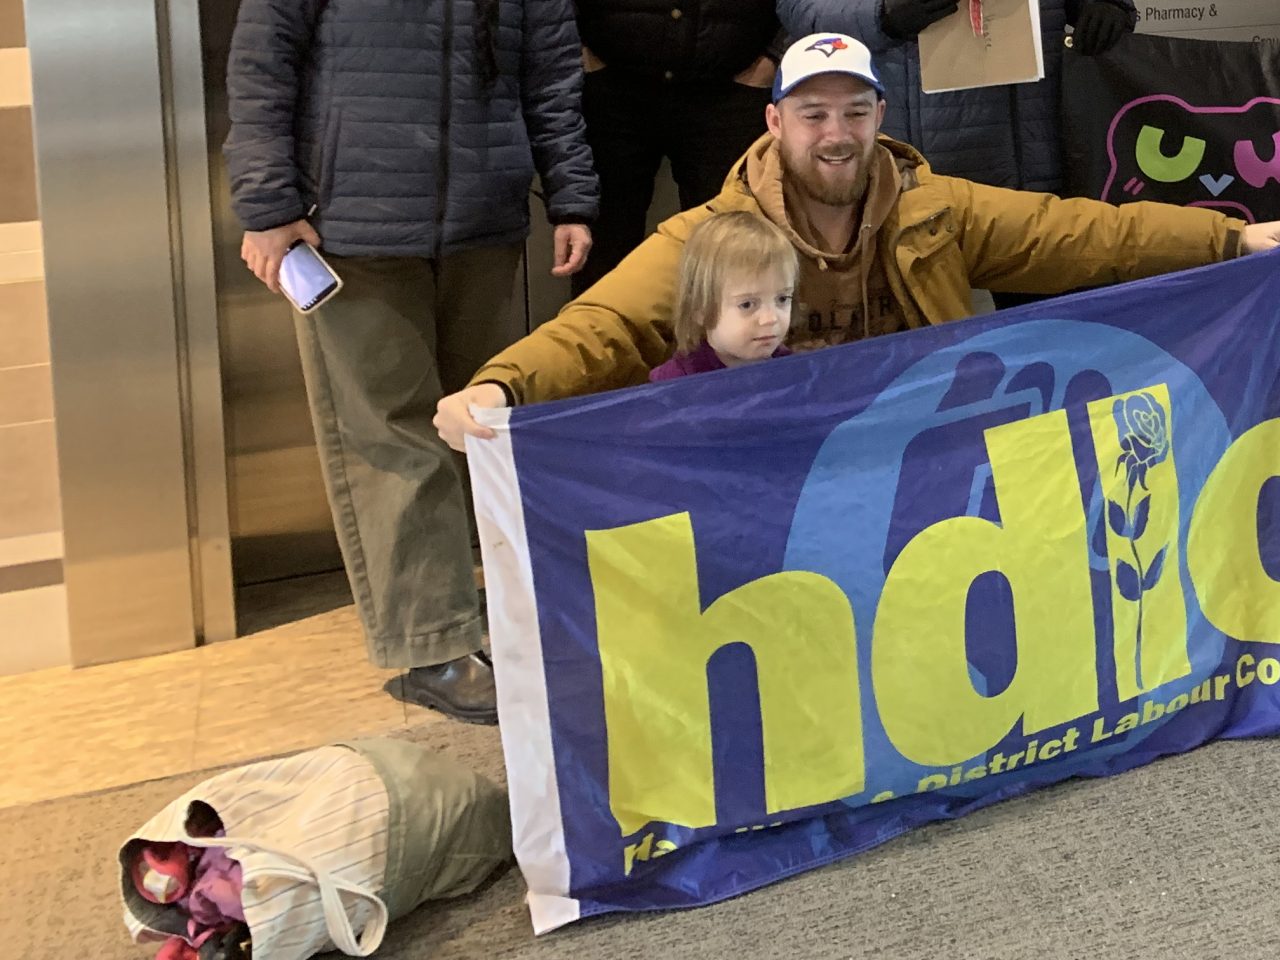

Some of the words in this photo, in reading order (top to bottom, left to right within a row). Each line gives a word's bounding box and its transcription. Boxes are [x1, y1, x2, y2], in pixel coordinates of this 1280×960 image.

[1145, 5, 1204, 21] Pharmacy
[1208, 3, 1218, 17] &
[916, 726, 1080, 793] District
[1090, 673, 1230, 743] Labour
